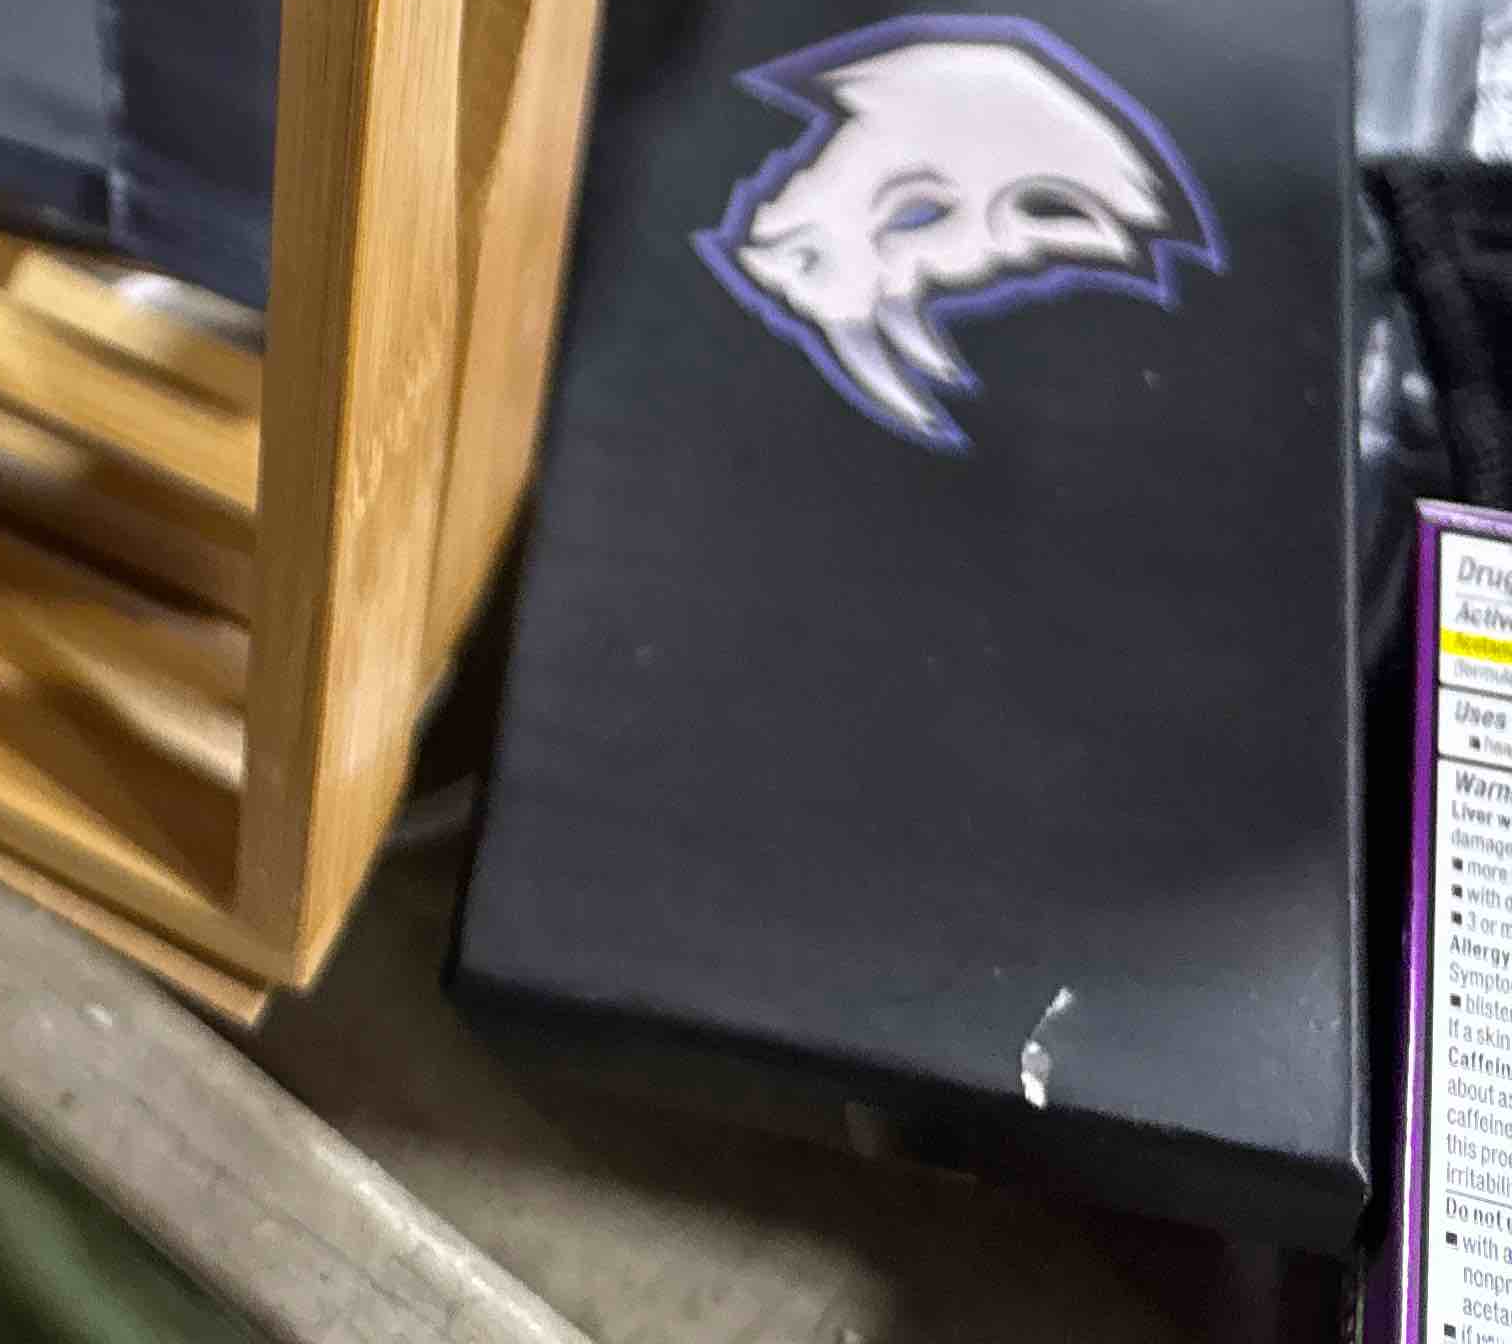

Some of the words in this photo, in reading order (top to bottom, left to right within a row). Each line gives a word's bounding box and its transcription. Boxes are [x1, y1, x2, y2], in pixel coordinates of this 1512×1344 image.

[1455, 700, 1506, 729] Uses
[1455, 770, 1512, 804] Warn
[1451, 800, 1492, 824] Liver
[1468, 862, 1507, 881] more
[1467, 887, 1500, 908] with
[1468, 911, 1476, 931] 3
[1481, 918, 1497, 935] or
[1449, 934, 1509, 969] Allergy
[1449, 1017, 1458, 1039] If
[1463, 1025, 1472, 1042] a
[1477, 1026, 1510, 1051] skin
[1448, 1077, 1494, 1105] about
[1447, 1134, 1476, 1160] this
[1447, 1197, 1468, 1222] Do
[1474, 1208, 1502, 1232] not
[1463, 1236, 1498, 1261] with
